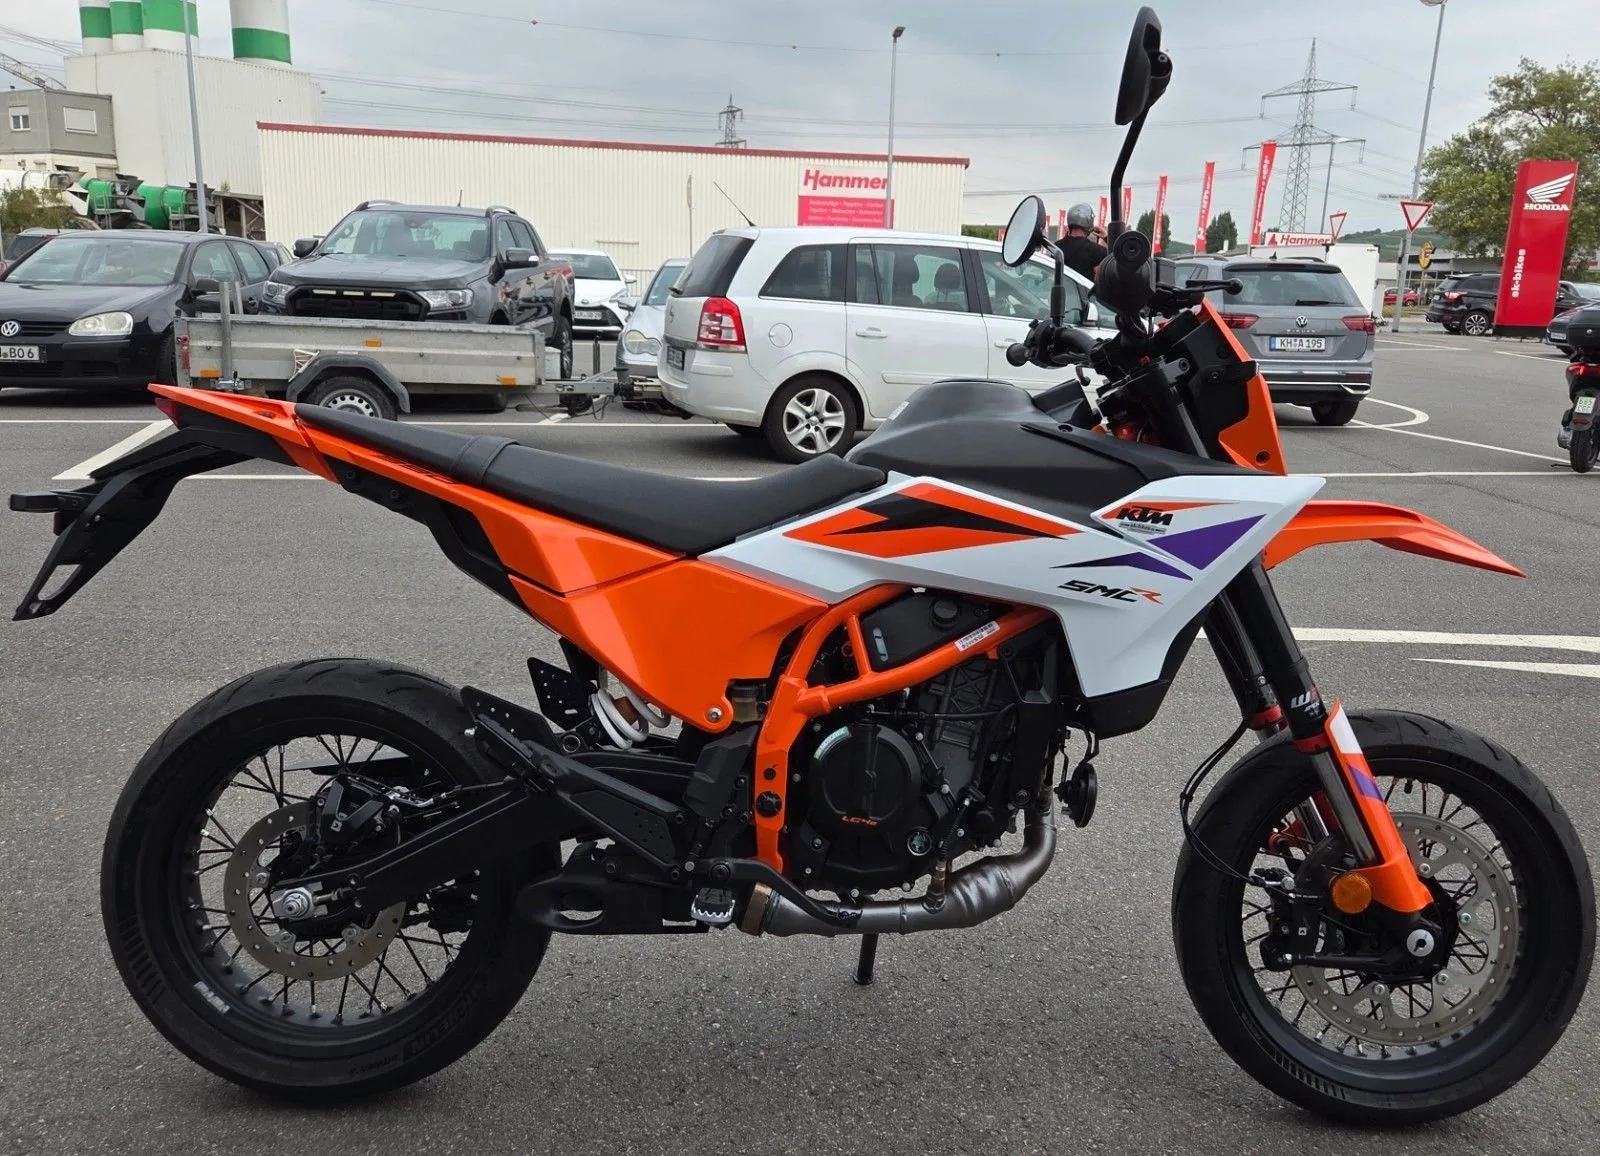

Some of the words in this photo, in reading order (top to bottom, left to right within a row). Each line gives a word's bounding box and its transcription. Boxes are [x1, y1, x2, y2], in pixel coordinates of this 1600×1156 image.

[803, 169, 888, 191] Hammer
[1523, 202, 1570, 211] HONDA
[1280, 234, 1331, 246] Hammer
[1511, 248, 1526, 298] sk-bikes
[1280, 338, 1293, 348] KH
[1306, 339, 1322, 348] 195
[1116, 505, 1174, 526] KTM
